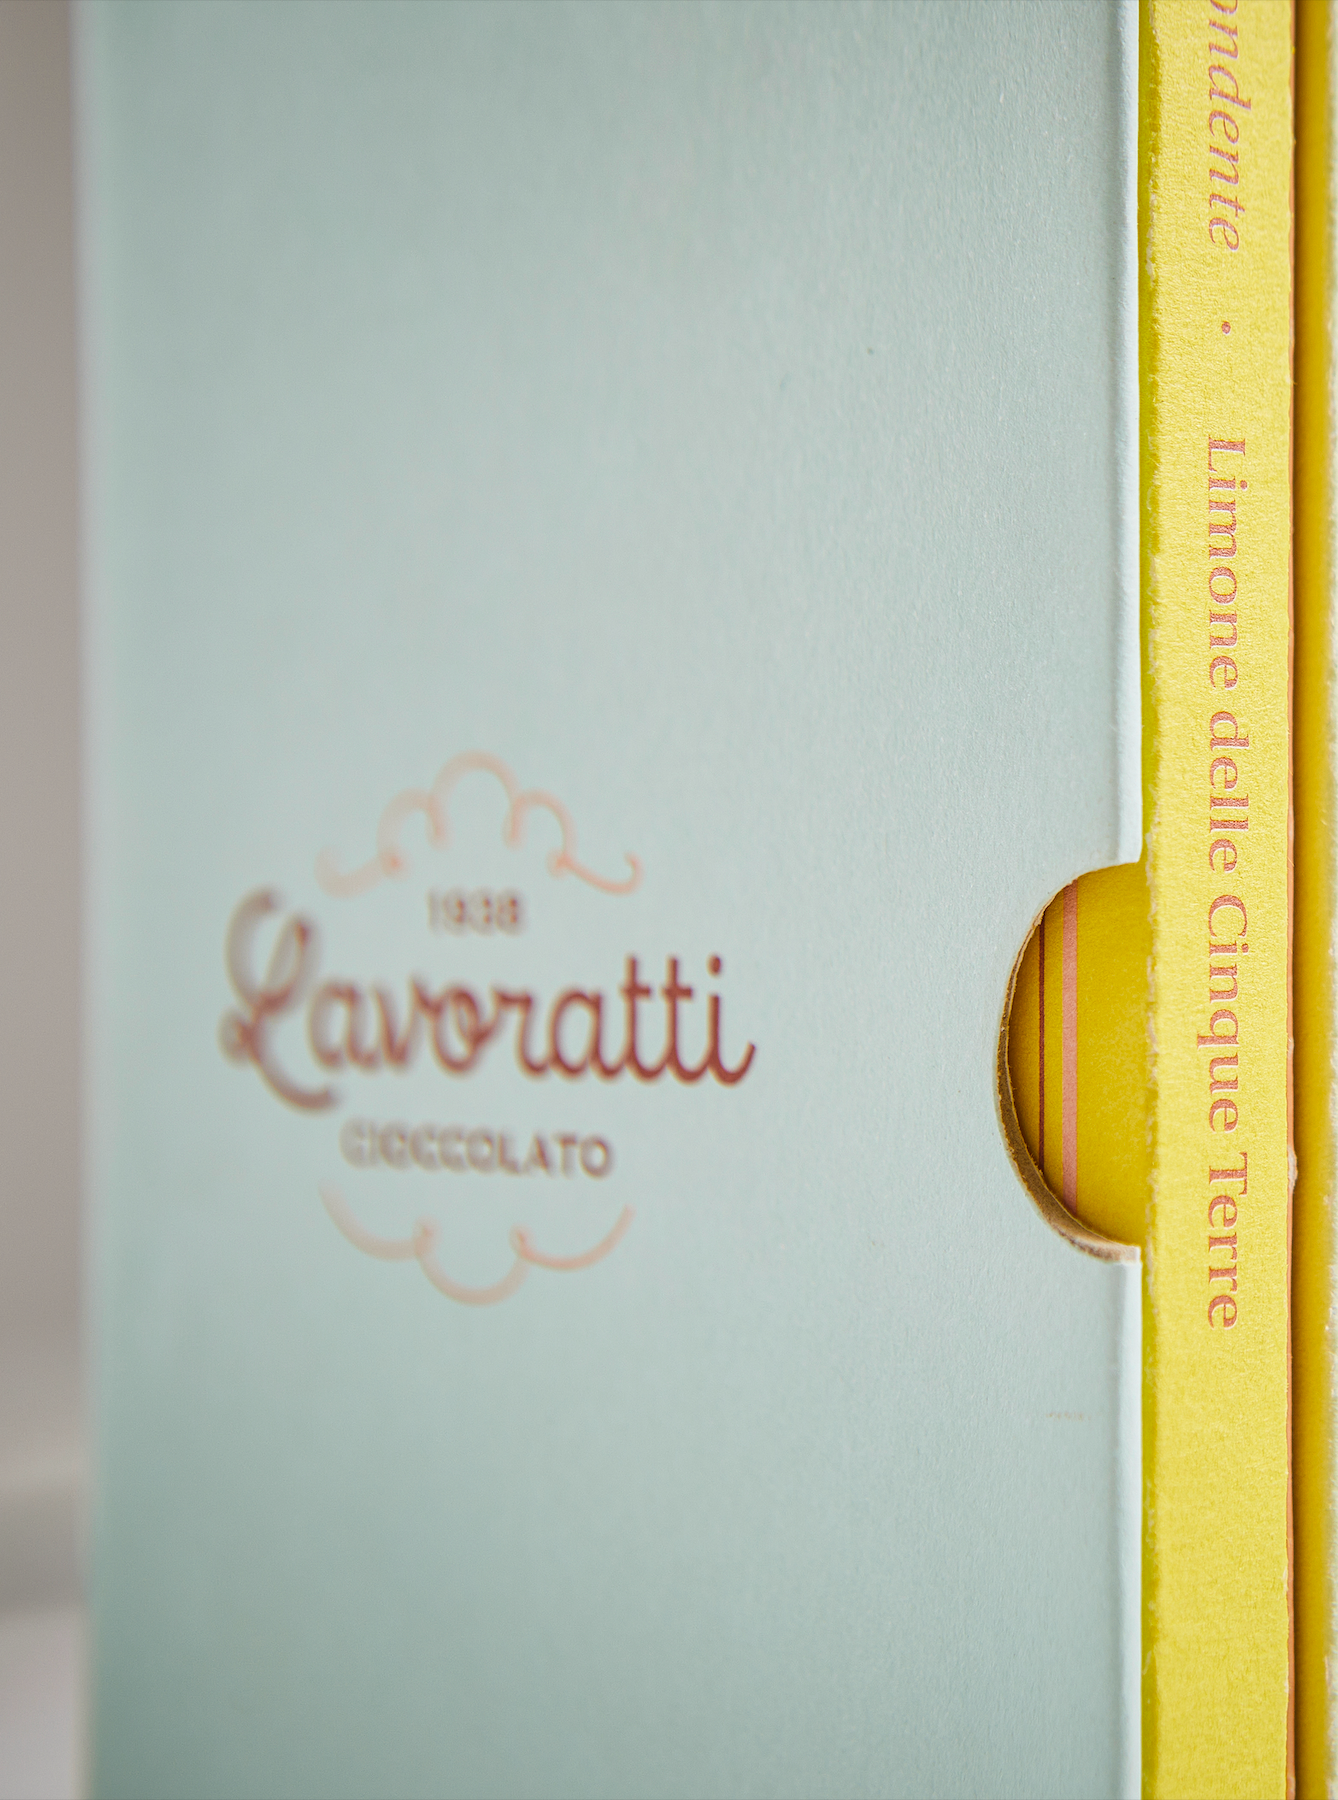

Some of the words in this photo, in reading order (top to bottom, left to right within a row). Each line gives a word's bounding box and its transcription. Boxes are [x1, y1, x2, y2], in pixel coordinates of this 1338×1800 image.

[1207, 435, 1248, 692] Limone
[1207, 710, 1250, 874] delle
[218, 885, 757, 1116] Lavoratti
[427, 889, 525, 937] 1938
[1196, 893, 1250, 1135] Cinque
[339, 1118, 614, 1180] CIOCCOLATO
[1207, 1151, 1249, 1331] Terre
